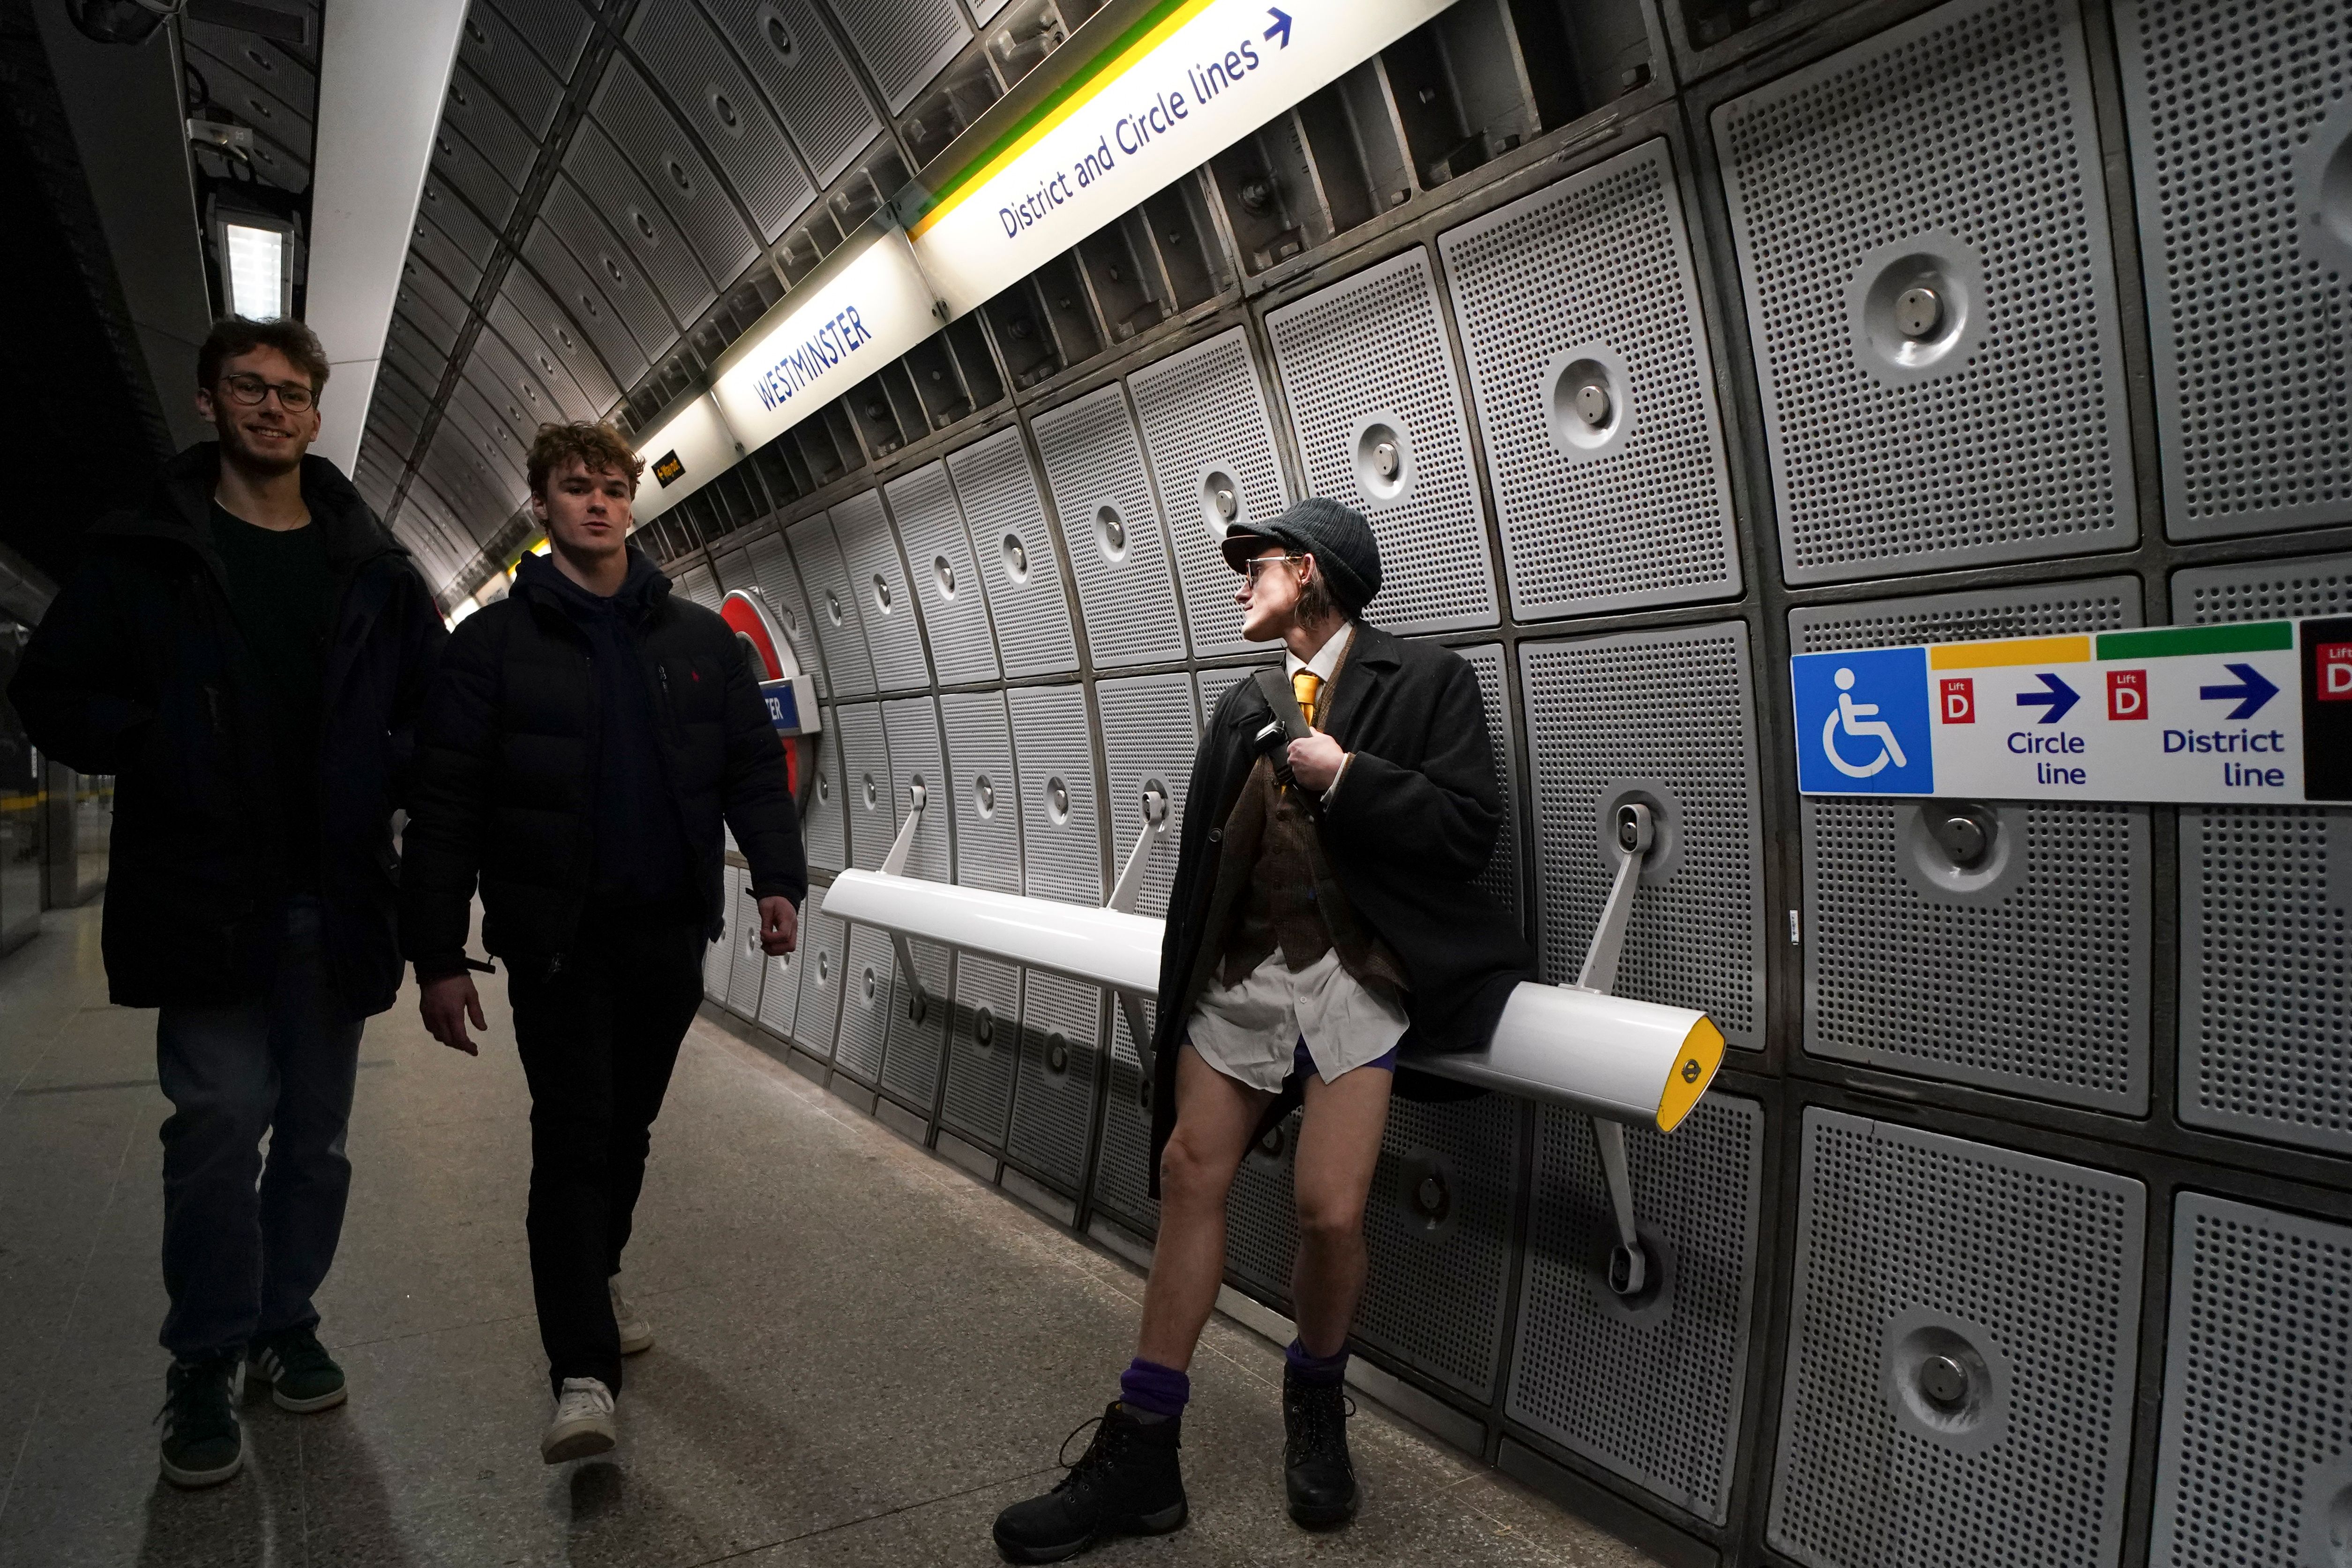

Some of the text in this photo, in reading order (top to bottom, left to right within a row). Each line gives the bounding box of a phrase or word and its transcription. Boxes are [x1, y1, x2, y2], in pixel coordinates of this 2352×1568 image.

[999, 39, 1259, 238] District and Circle lines
[753, 305, 872, 412] WESTMINSTER
[1948, 683, 1965, 691] Lift
[2117, 675, 2136, 683] Lift
[1948, 694, 1969, 718] D
[2115, 688, 2140, 714] D
[2007, 732, 2085, 754] Circle
[2164, 728, 2285, 753] District
[2037, 763, 2086, 784] line
[2225, 762, 2285, 786] line
